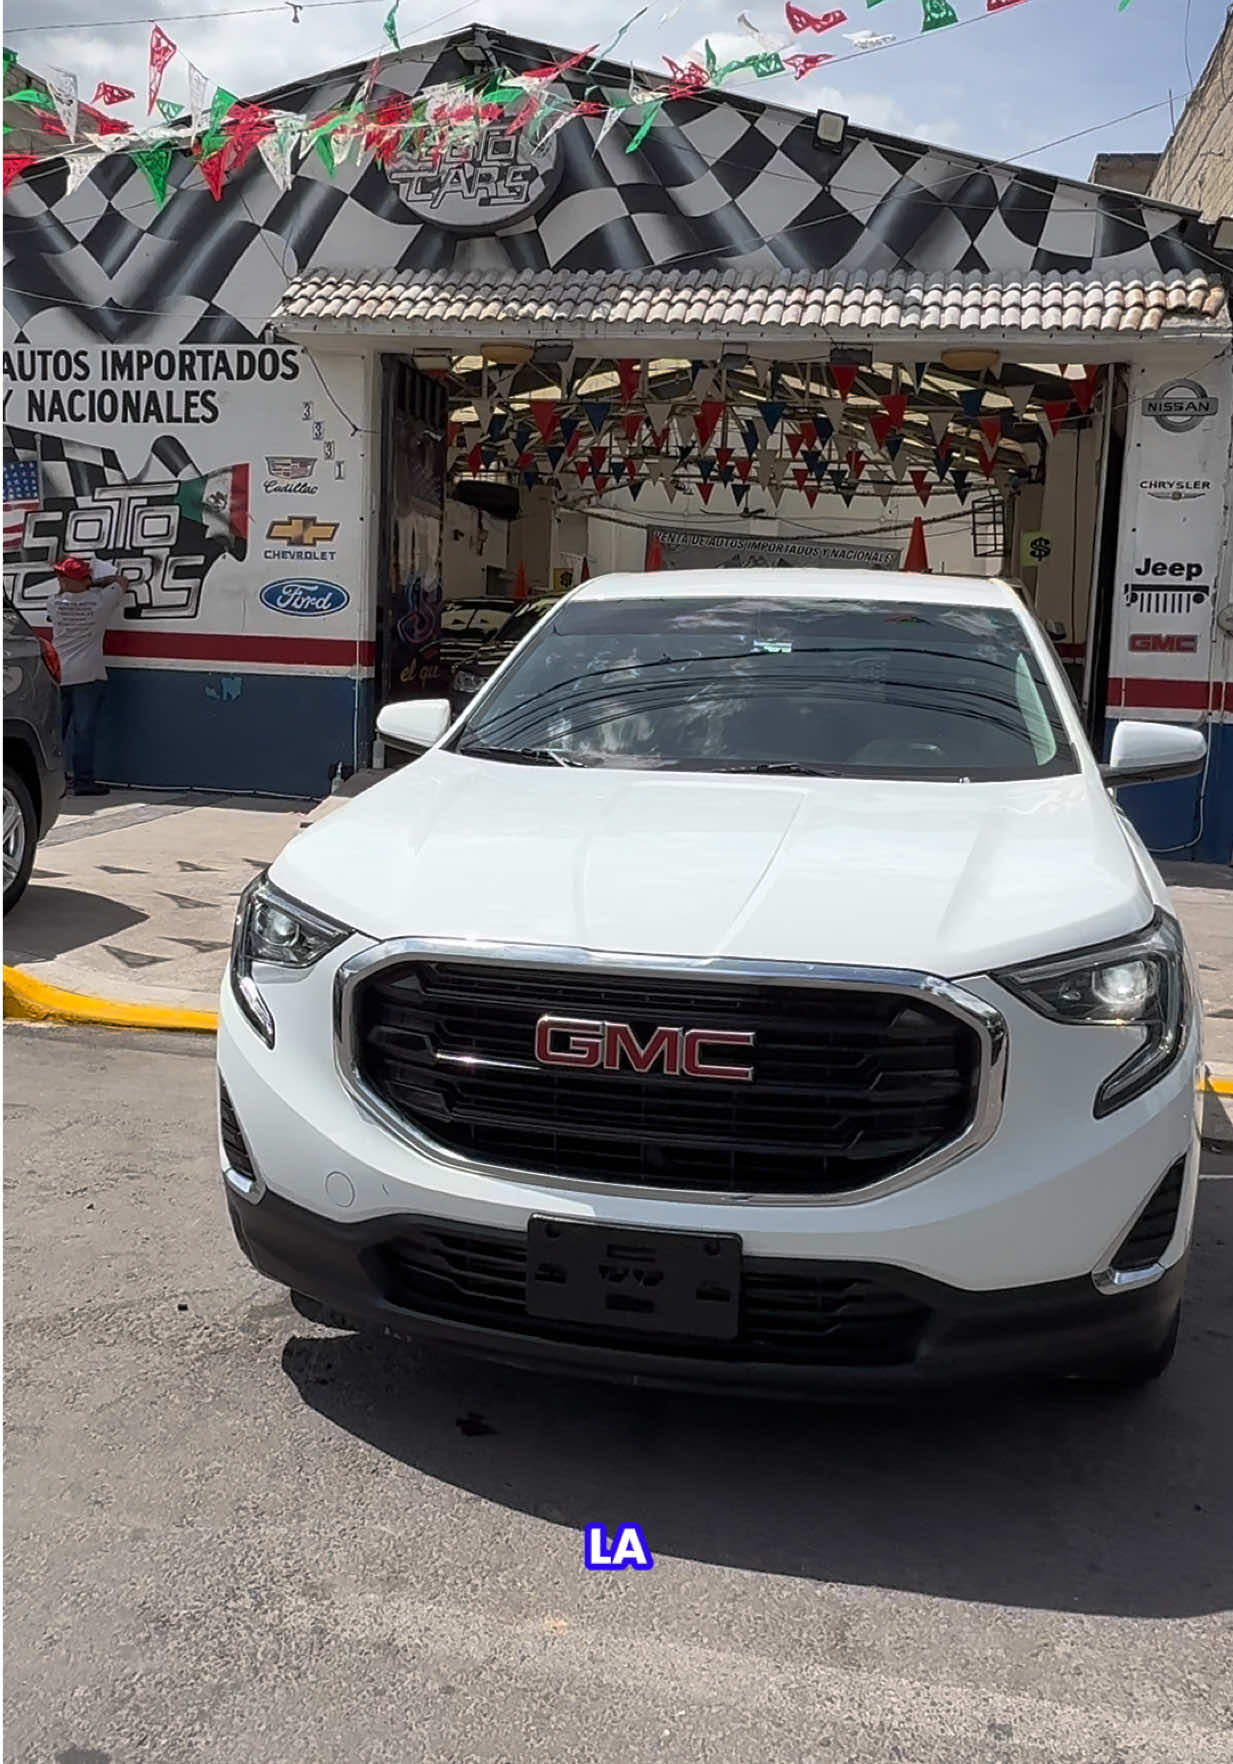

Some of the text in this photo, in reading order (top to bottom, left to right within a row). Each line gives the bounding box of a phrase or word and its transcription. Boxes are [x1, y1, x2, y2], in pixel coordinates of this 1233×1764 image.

[389, 163, 533, 209] CARS
[3, 349, 300, 382] AUTOS IMPORTADOS
[27, 388, 219, 423] NACIONALES
[1147, 401, 1210, 412] NISSAN
[264, 480, 319, 494] Cadillac
[1140, 480, 1211, 489] CHRYSLER
[264, 550, 336, 560] CHEVROLET
[746, 540, 819, 555] IMPORTADOS
[1135, 557, 1203, 581] Jeep
[3, 553, 206, 620] CRS
[276, 583, 332, 609] Ford
[1128, 633, 1198, 653] GMC
[535, 1014, 756, 1081] GMC
